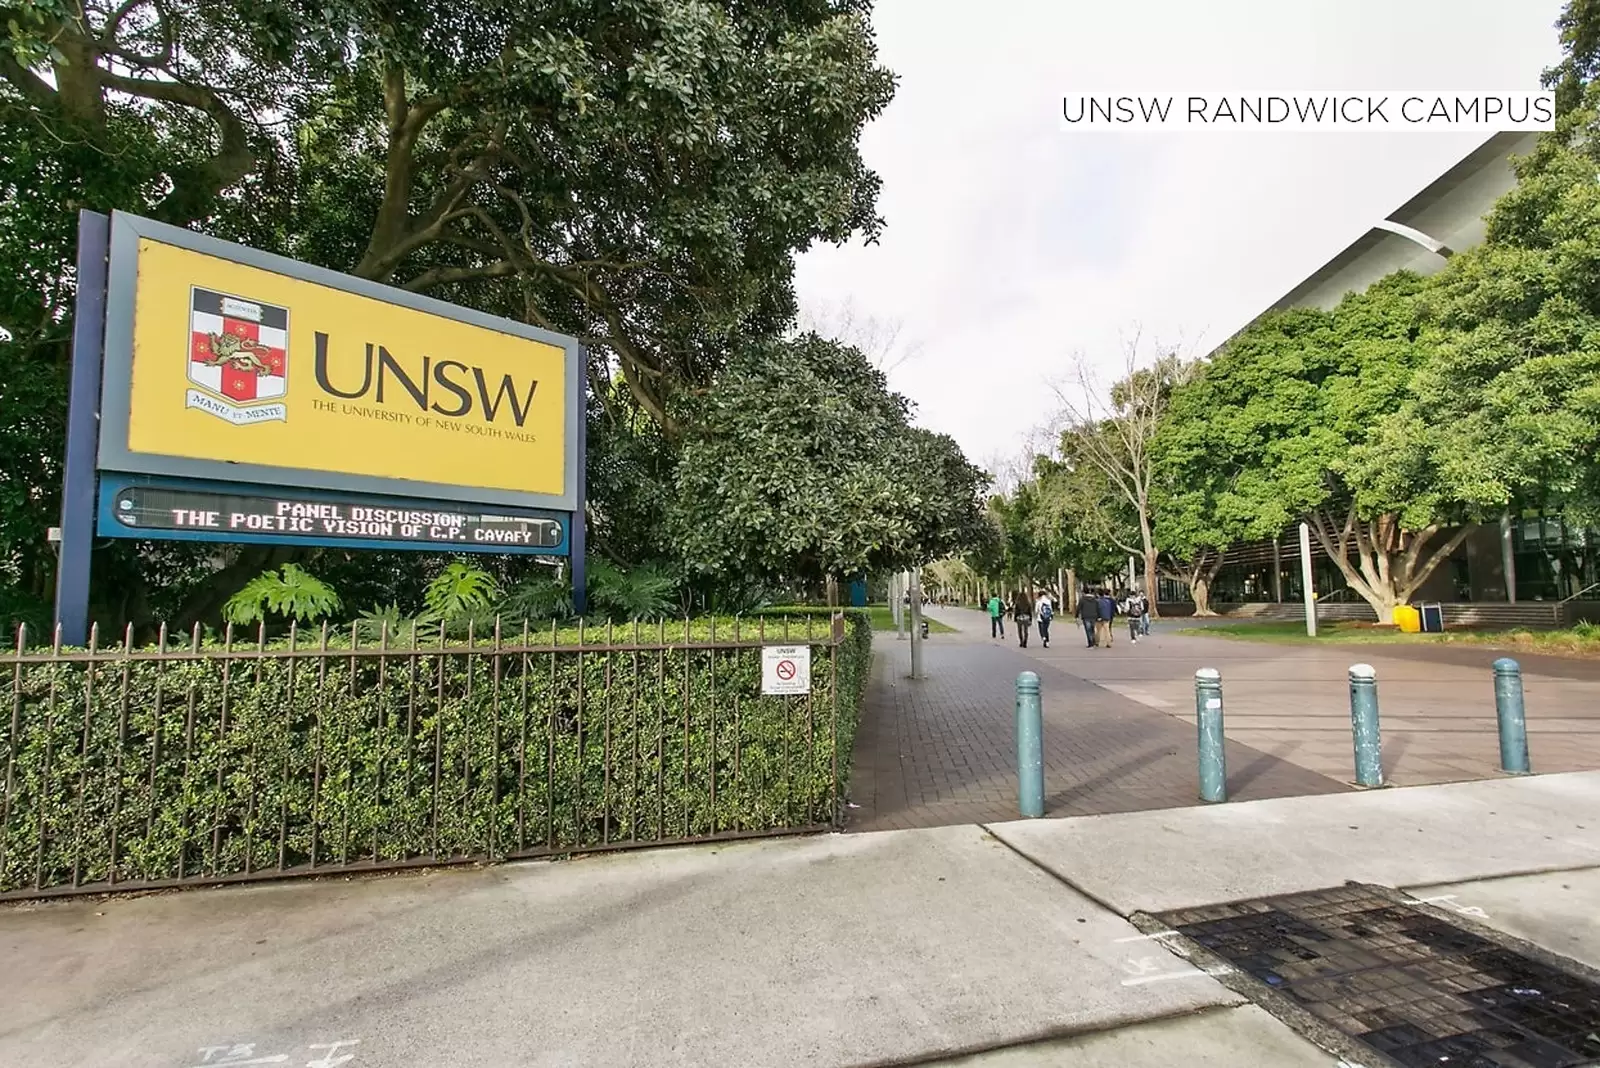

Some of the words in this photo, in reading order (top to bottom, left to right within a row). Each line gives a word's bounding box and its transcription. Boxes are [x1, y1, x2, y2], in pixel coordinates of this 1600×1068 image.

[315, 331, 538, 427] UNSW
[193, 395, 229, 415] MANU
[245, 407, 281, 419] MENTE
[312, 399, 337, 413] THE
[342, 404, 412, 424] UNIVERSITY
[415, 416, 431, 427] OF
[435, 420, 461, 432] NEW
[465, 424, 501, 438] SOUTH
[505, 431, 536, 443] WALES
[172, 509, 220, 527] THE
[230, 512, 313, 532] POETIC
[323, 518, 392, 537] VISION
[401, 524, 421, 538] OF
[430, 526, 466, 541] C.P.
[474, 528, 532, 544] CAVAFY
[277, 502, 342, 520] PANEL
[352, 507, 467, 528] DISCUSSION:
